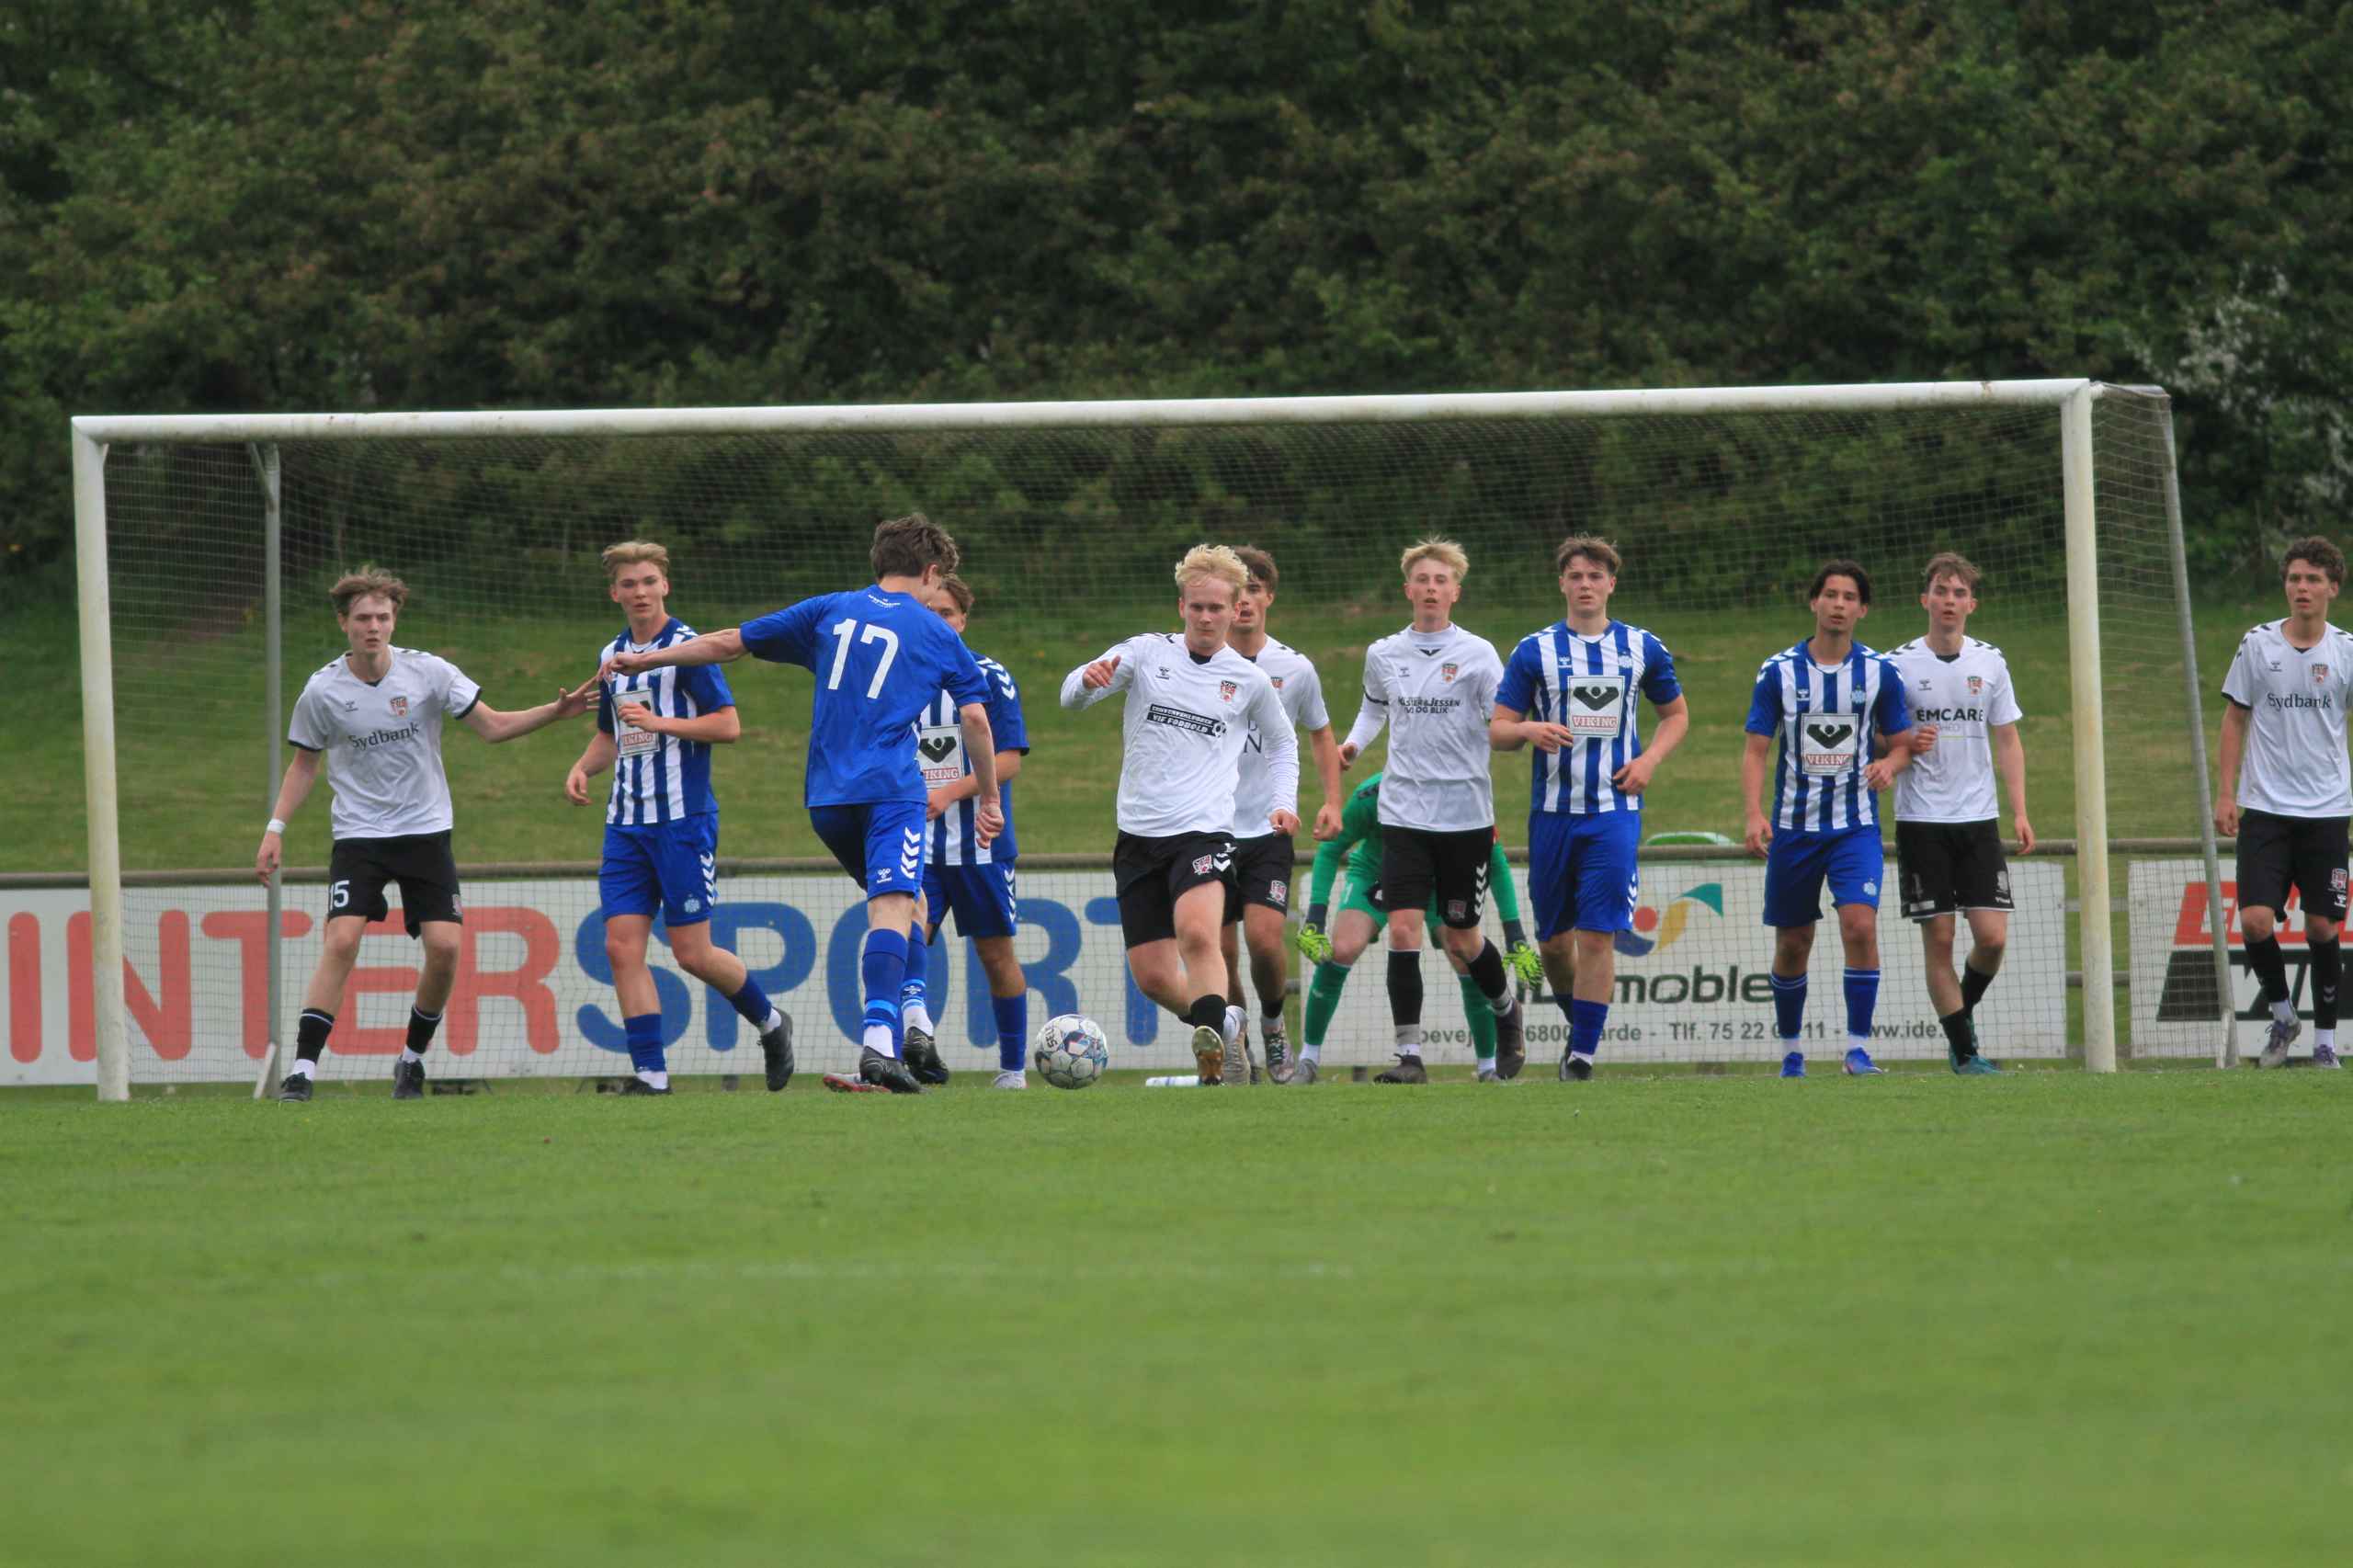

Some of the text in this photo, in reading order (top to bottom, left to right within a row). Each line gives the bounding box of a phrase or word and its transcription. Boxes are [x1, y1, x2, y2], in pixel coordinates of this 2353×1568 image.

[827, 618, 899, 699] 17
[2267, 692, 2331, 711] Sydbank
[1574, 717, 1618, 727] VIKING
[348, 722, 419, 751] Sydbank
[925, 767, 959, 779] IKING
[1669, 1022, 1700, 1040] Tlf.
[1710, 1022, 1733, 1040] 75
[1741, 1022, 1765, 1040] 22
[1804, 1021, 1825, 1040] 11
